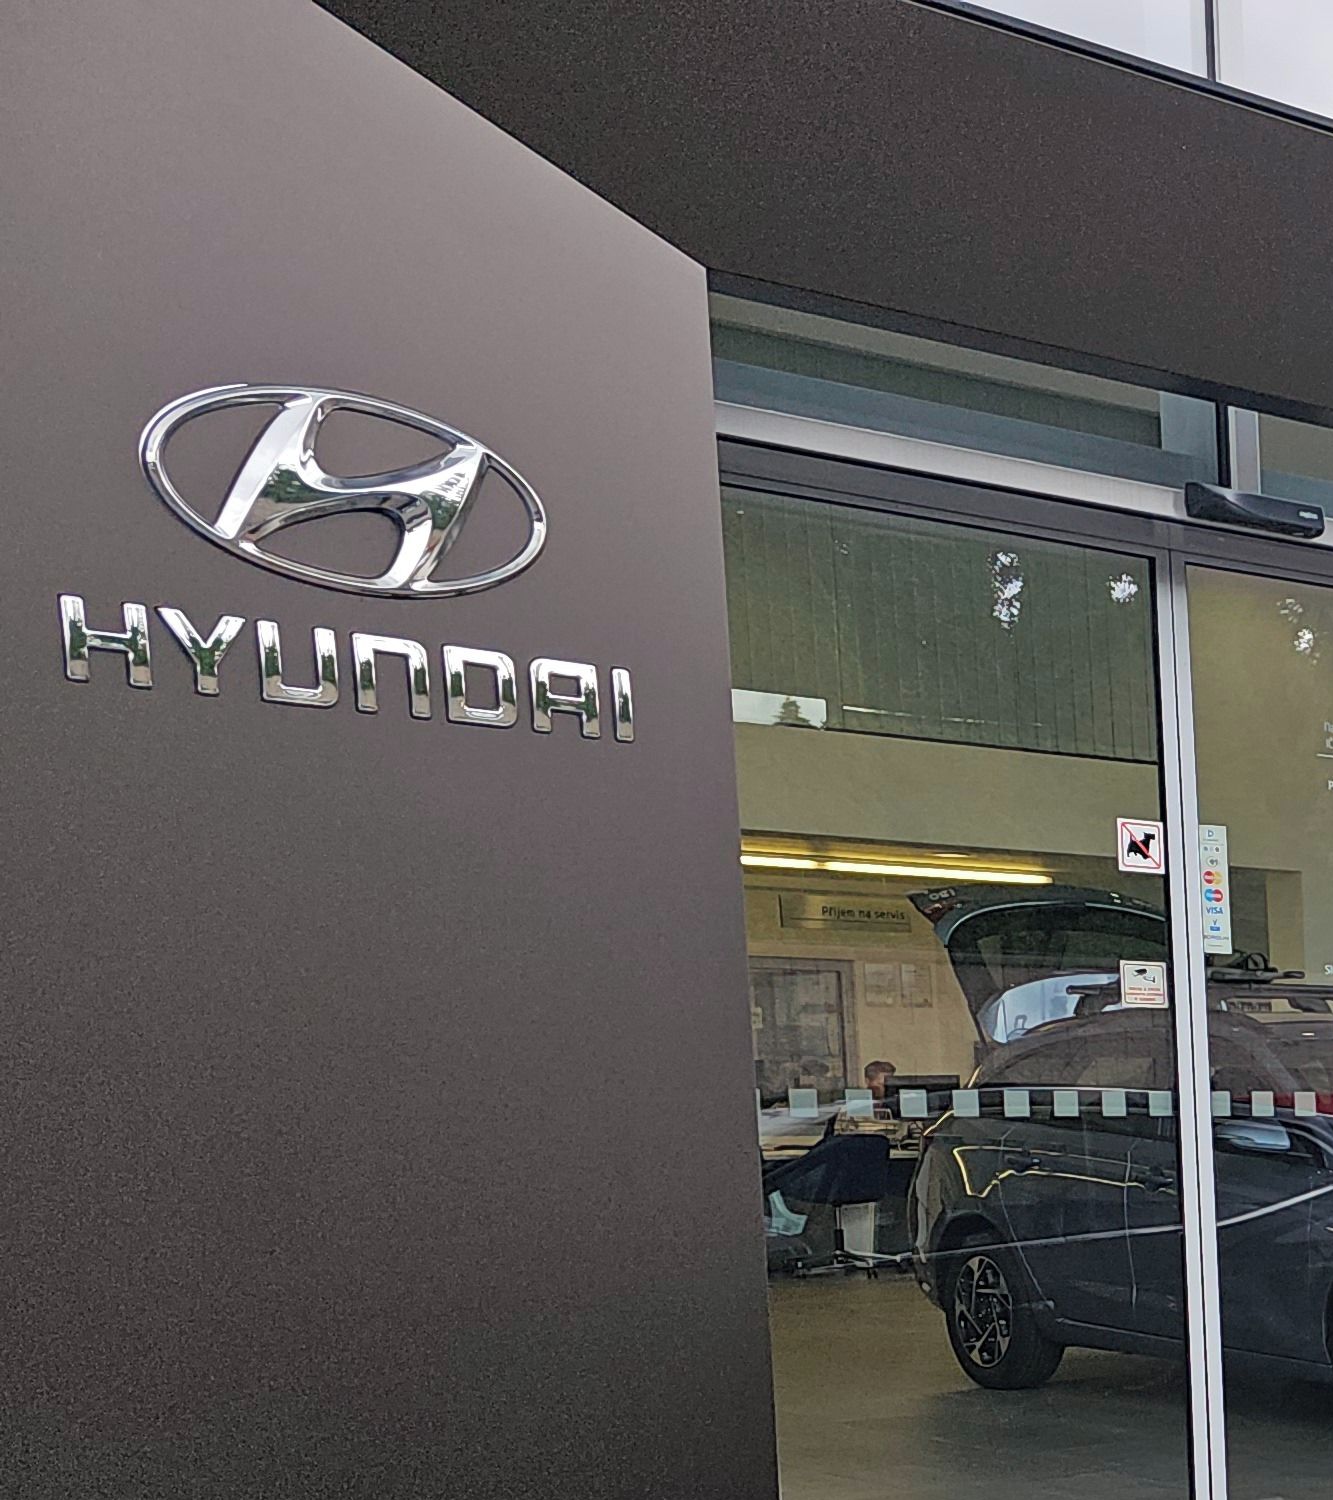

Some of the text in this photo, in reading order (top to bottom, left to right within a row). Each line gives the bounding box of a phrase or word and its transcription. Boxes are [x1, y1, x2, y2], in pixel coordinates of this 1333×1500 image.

[57, 592, 635, 742] HYUNDAI
[858, 909, 870, 919] na
[873, 909, 904, 920] servis
